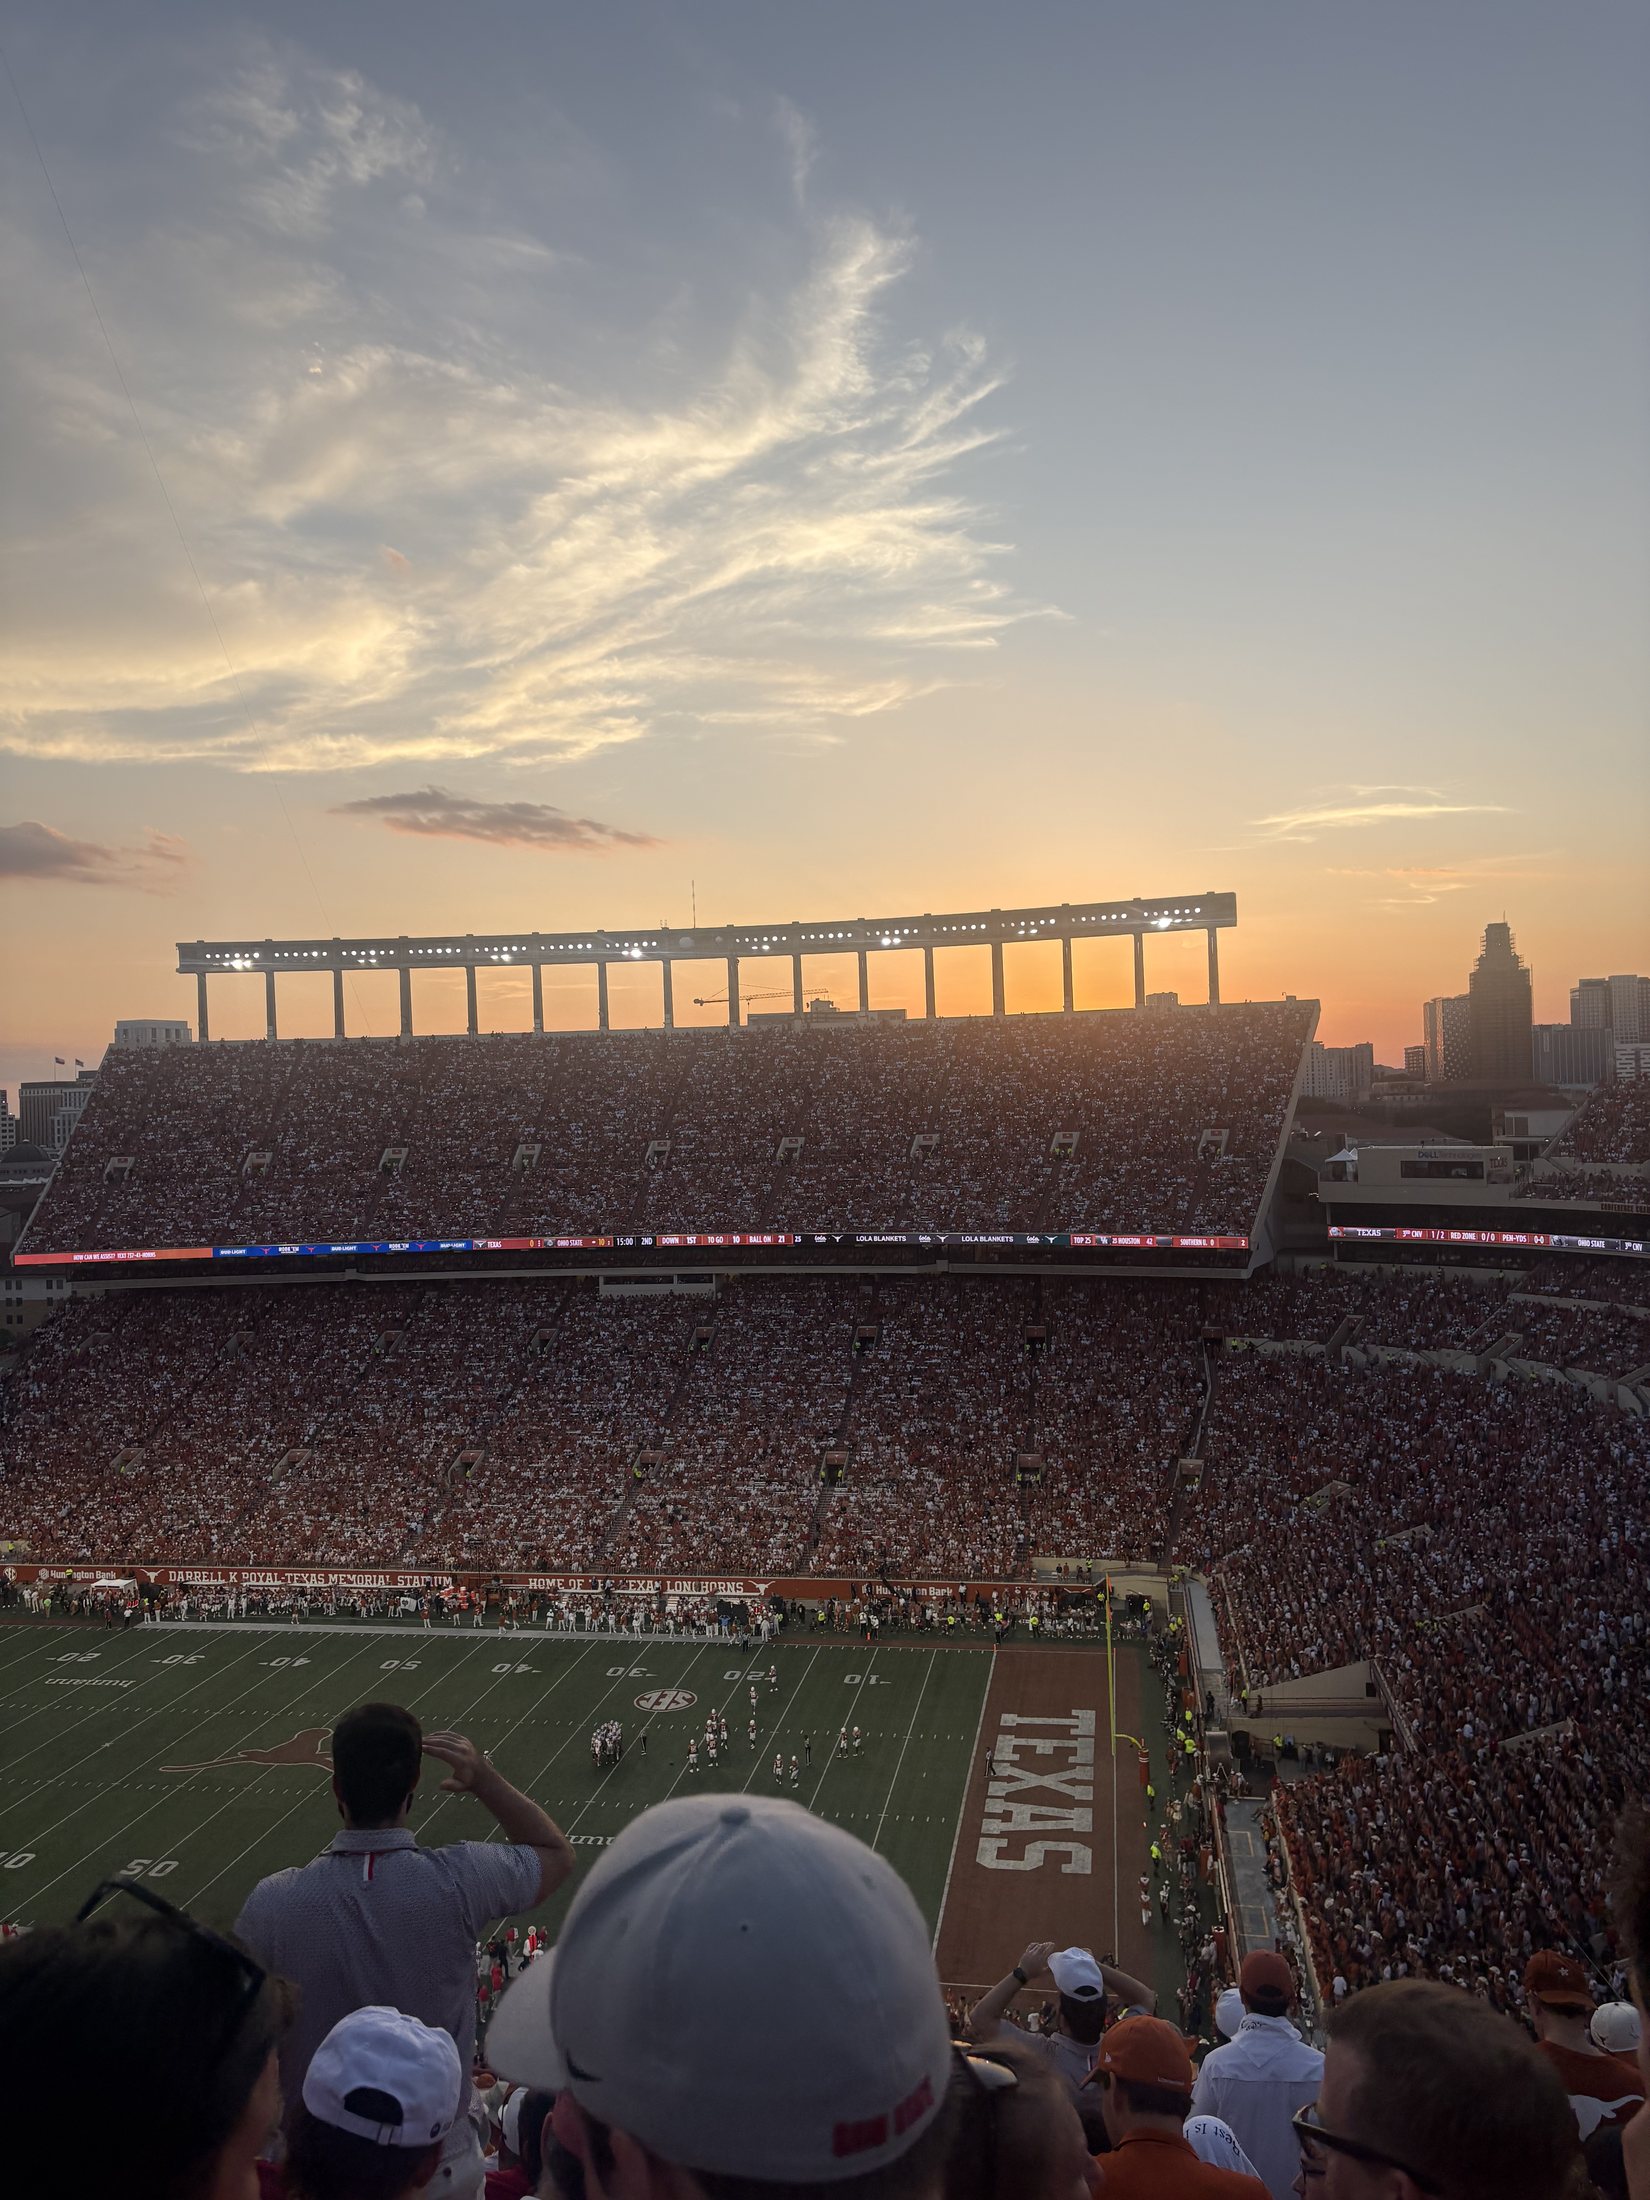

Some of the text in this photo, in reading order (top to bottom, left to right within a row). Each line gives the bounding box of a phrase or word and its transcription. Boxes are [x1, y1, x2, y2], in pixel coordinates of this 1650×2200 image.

[616, 1237, 633, 1246] 15:00
[50, 1570, 116, 1580] Hunngton Bank
[169, 1570, 226, 1583] DARRELL
[229, 1572, 238, 1583] K
[528, 1578, 565, 1590] HOME
[569, 1579, 584, 1590] OF
[56, 1652, 102, 1662] 20
[161, 1654, 206, 1665] 30
[270, 1657, 312, 1667] 40
[379, 1660, 422, 1670] 50
[492, 1663, 532, 1674] 40
[606, 1666, 647, 1677] 30
[723, 1670, 765, 1681] 20
[843, 1674, 880, 1685] 10
[637, 1689, 695, 1710] SEC
[976, 1709, 1096, 1874] TEXAS
[120, 1859, 179, 1877] 50
[1195, 2124, 1206, 2135] Is
[1213, 2126, 1240, 2156] Best
